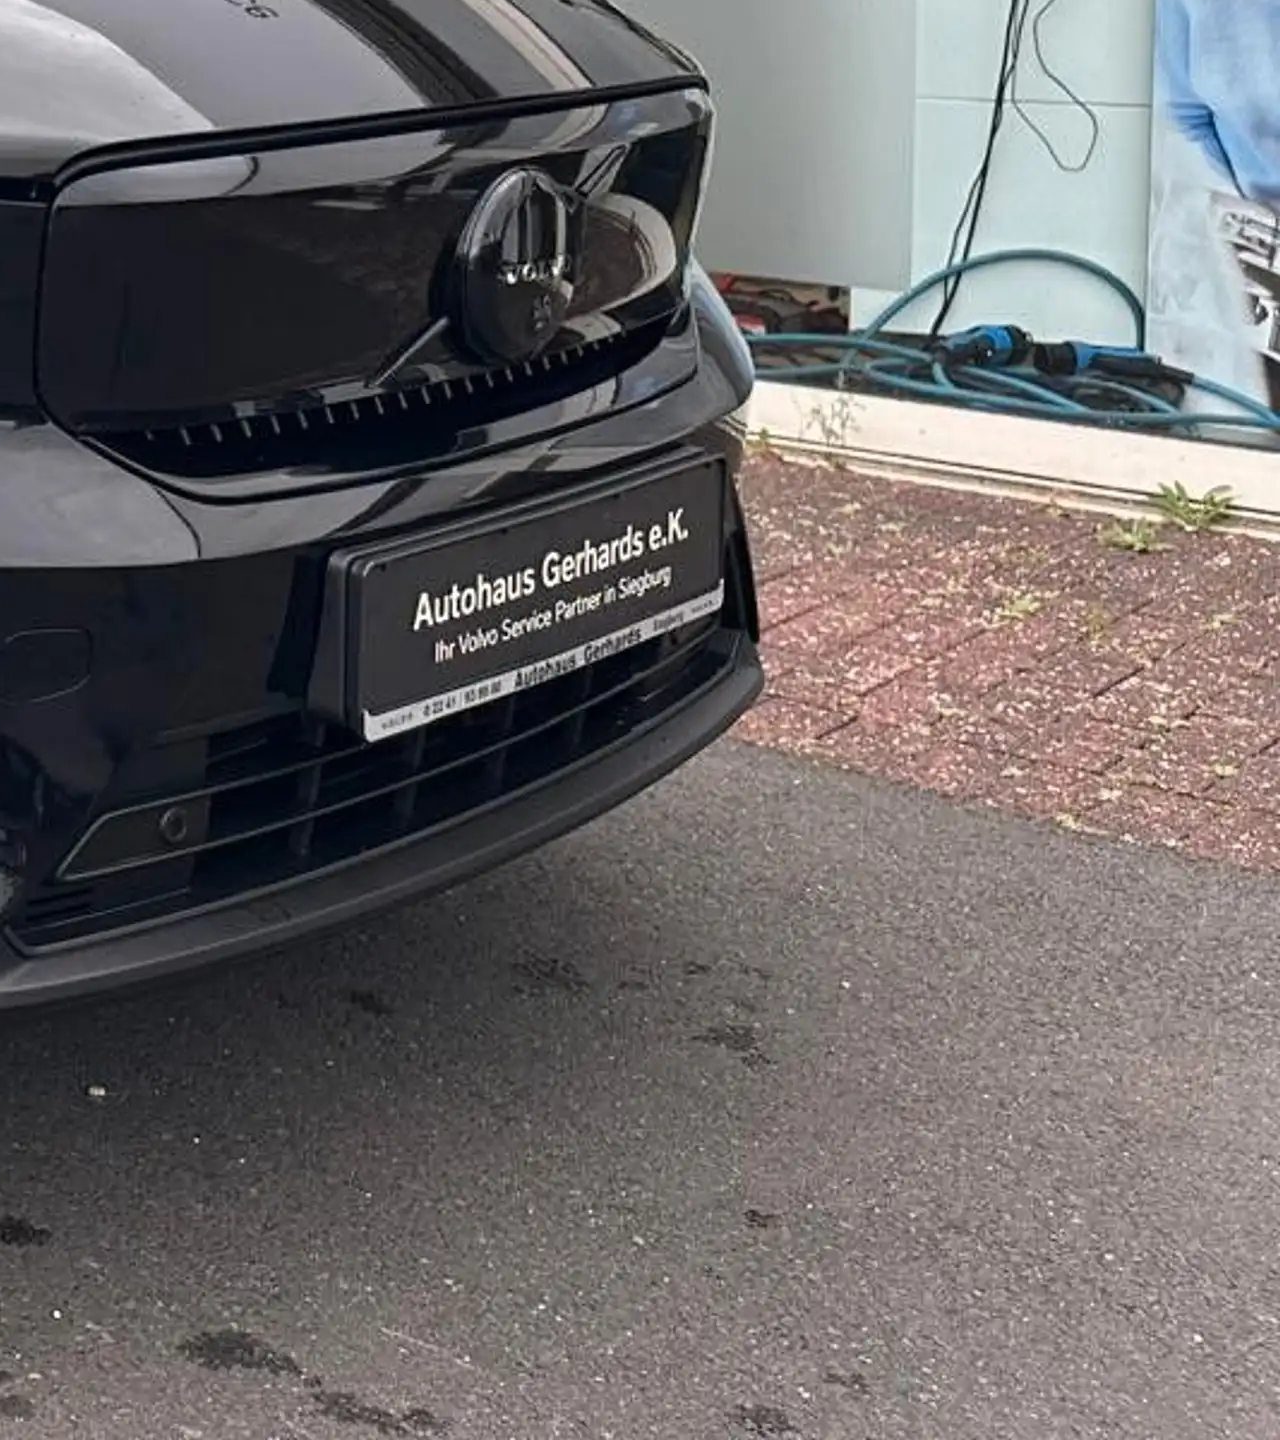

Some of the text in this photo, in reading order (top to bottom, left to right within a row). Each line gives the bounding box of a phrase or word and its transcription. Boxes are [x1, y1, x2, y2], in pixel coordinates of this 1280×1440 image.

[413, 508, 689, 630] Autohaus Gerhards e.K.
[434, 566, 672, 663] Ihr Volvo Service Partner in Siegburg
[515, 653, 577, 687] Autohaus
